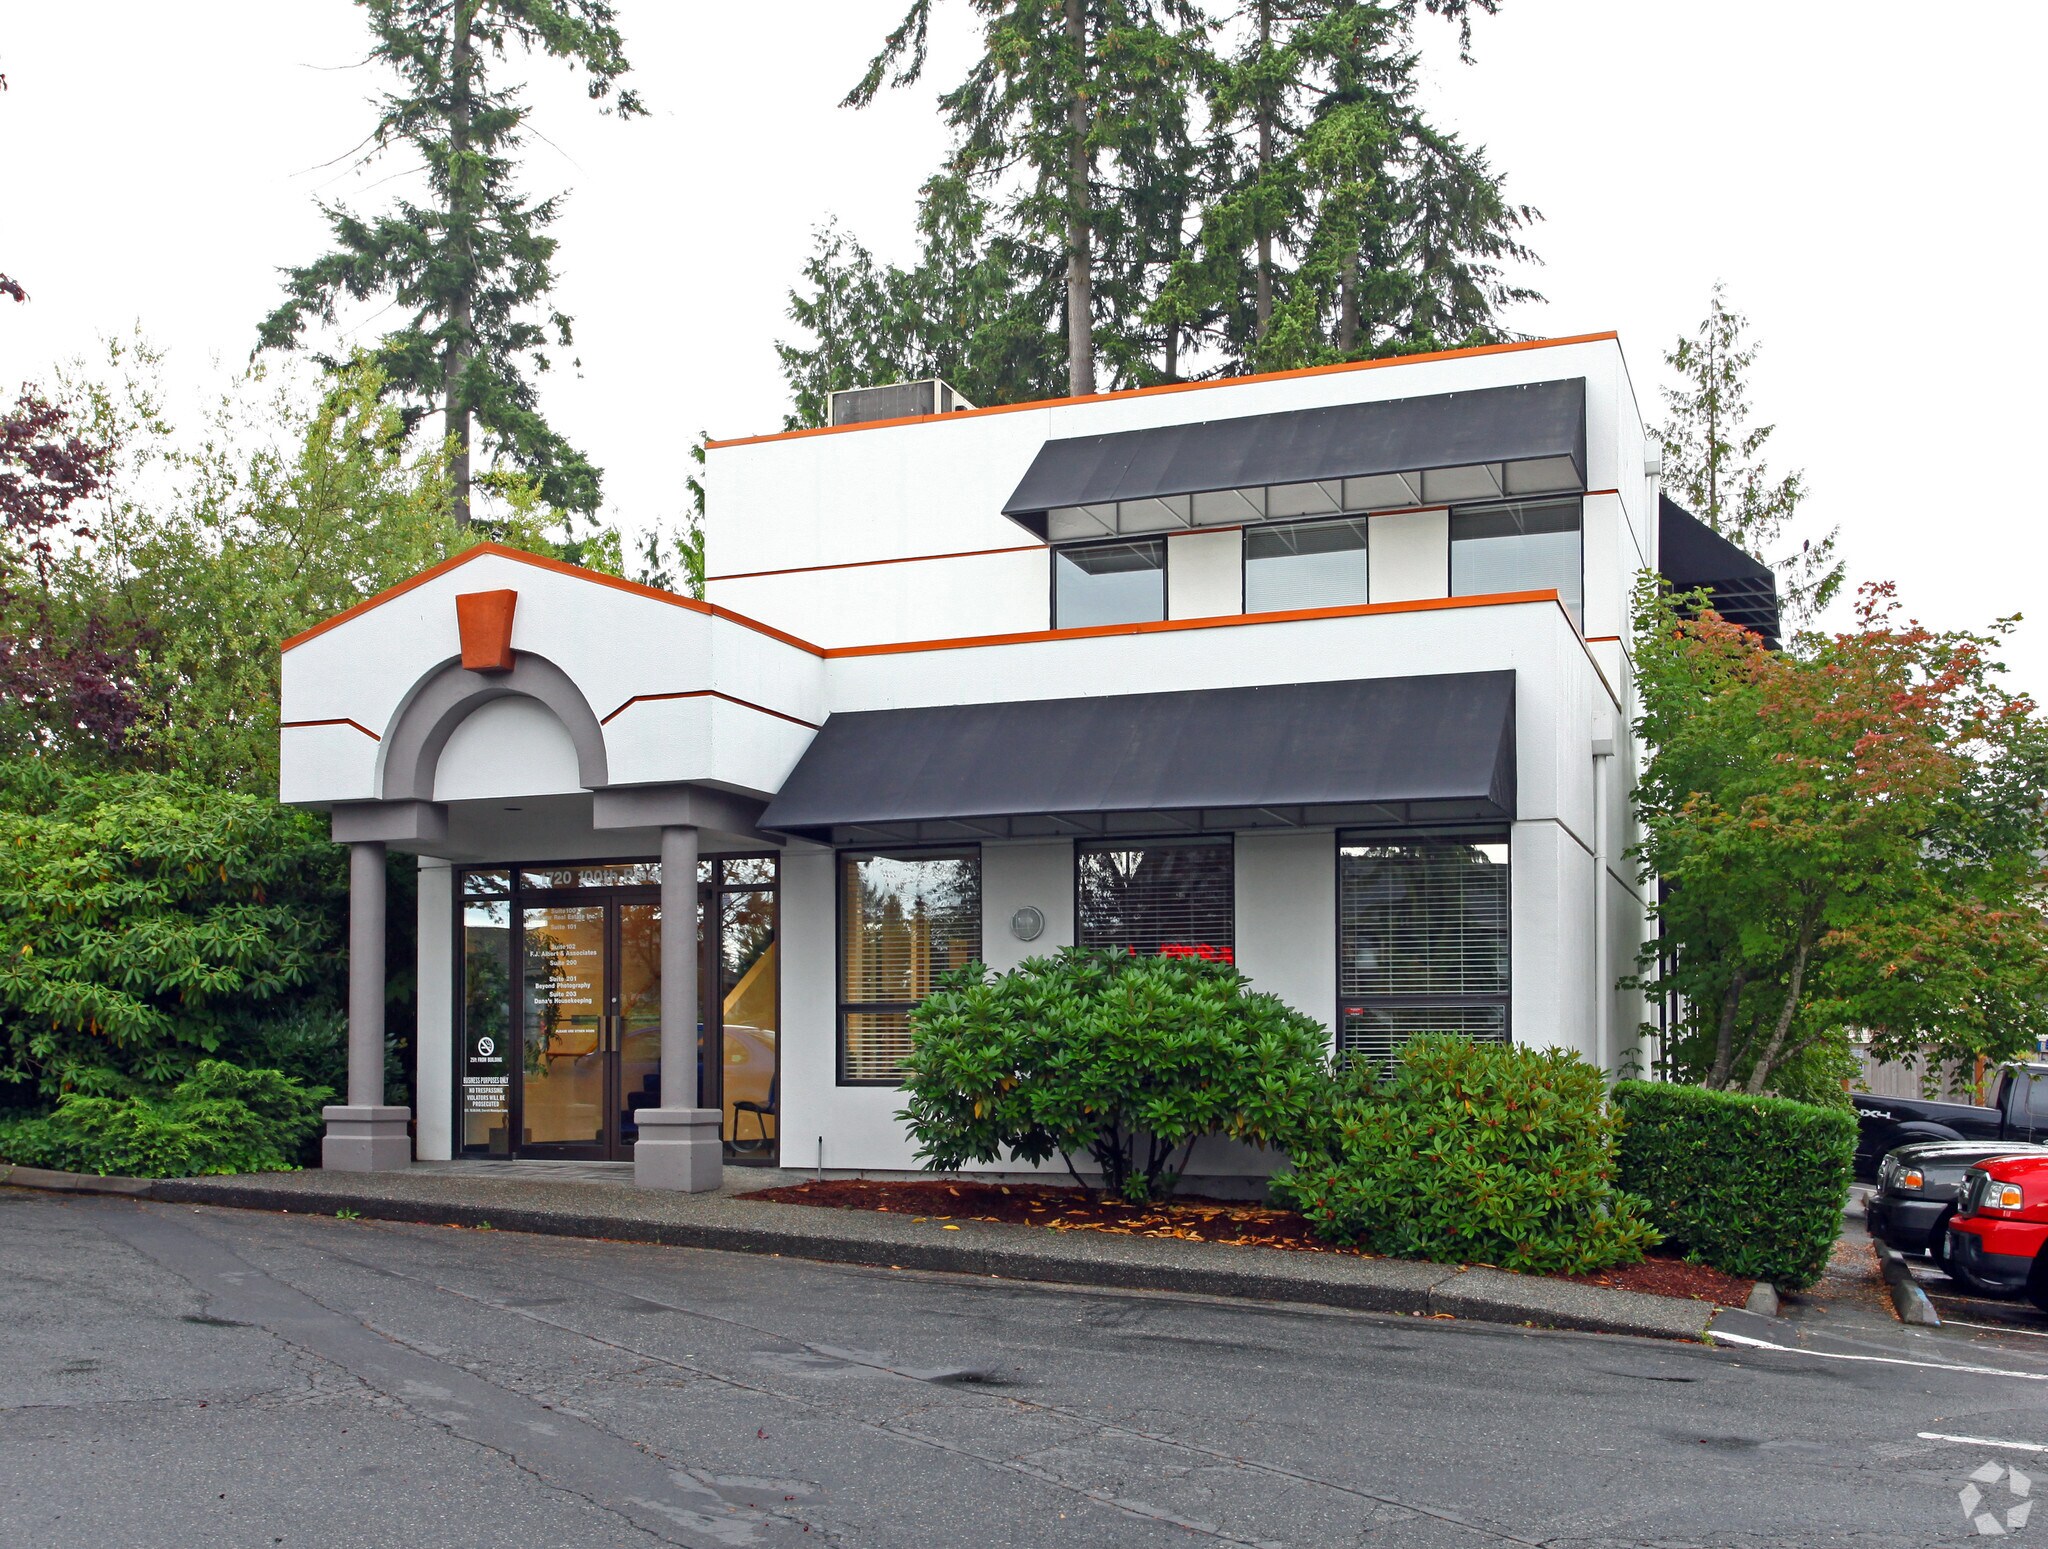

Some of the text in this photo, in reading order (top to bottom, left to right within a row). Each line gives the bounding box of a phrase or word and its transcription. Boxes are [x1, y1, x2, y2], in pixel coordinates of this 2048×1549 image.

[554, 997, 593, 1005] Housekeeping
[463, 1076, 480, 1084] BUSINESS
[480, 1076, 500, 1084] PURPOSES
